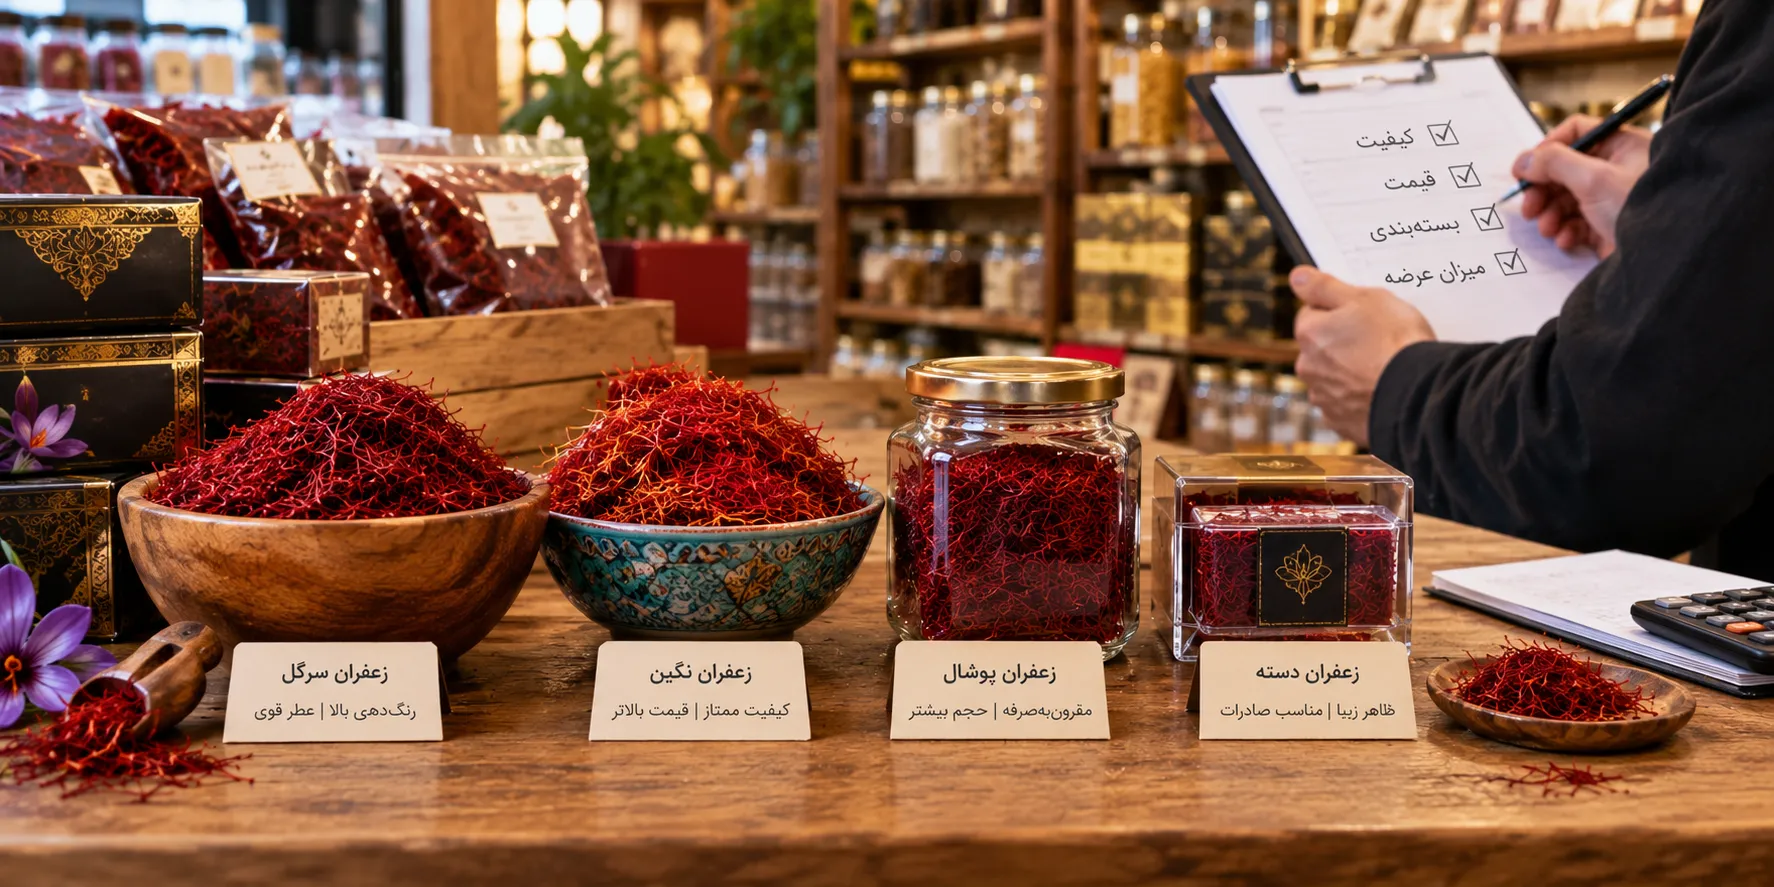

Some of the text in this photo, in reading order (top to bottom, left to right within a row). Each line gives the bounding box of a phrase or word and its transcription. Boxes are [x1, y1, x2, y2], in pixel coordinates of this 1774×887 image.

[1356, 127, 1414, 152] کیفیت
[1384, 169, 1437, 193] قیمت
[1369, 218, 1460, 242] بسته‌بندی
[1384, 260, 1486, 287] میزان عرضه
[281, 660, 389, 685] زعفران سرگل
[649, 660, 752, 685] زعفران نگین
[943, 663, 1057, 686] زعفران پوشال
[1255, 663, 1360, 685] زعفران دسته
[254, 702, 283, 721] قوی
[286, 702, 315, 721] عطر
[329, 703, 349, 720] بالا
[611, 702, 644, 721] بالاتر
[648, 702, 689, 720] قیمت
[702, 703, 740, 721] ممتاز
[744, 702, 791, 720] کیفیت
[908, 703, 949, 721] بیشتر
[952, 706, 988, 722] حجم
[1220, 703, 1271, 721] صادرات
[1275, 703, 1323, 720] مناسب
[1336, 703, 1359, 721] زیبا
[1361, 703, 1396, 721] ظاهر
